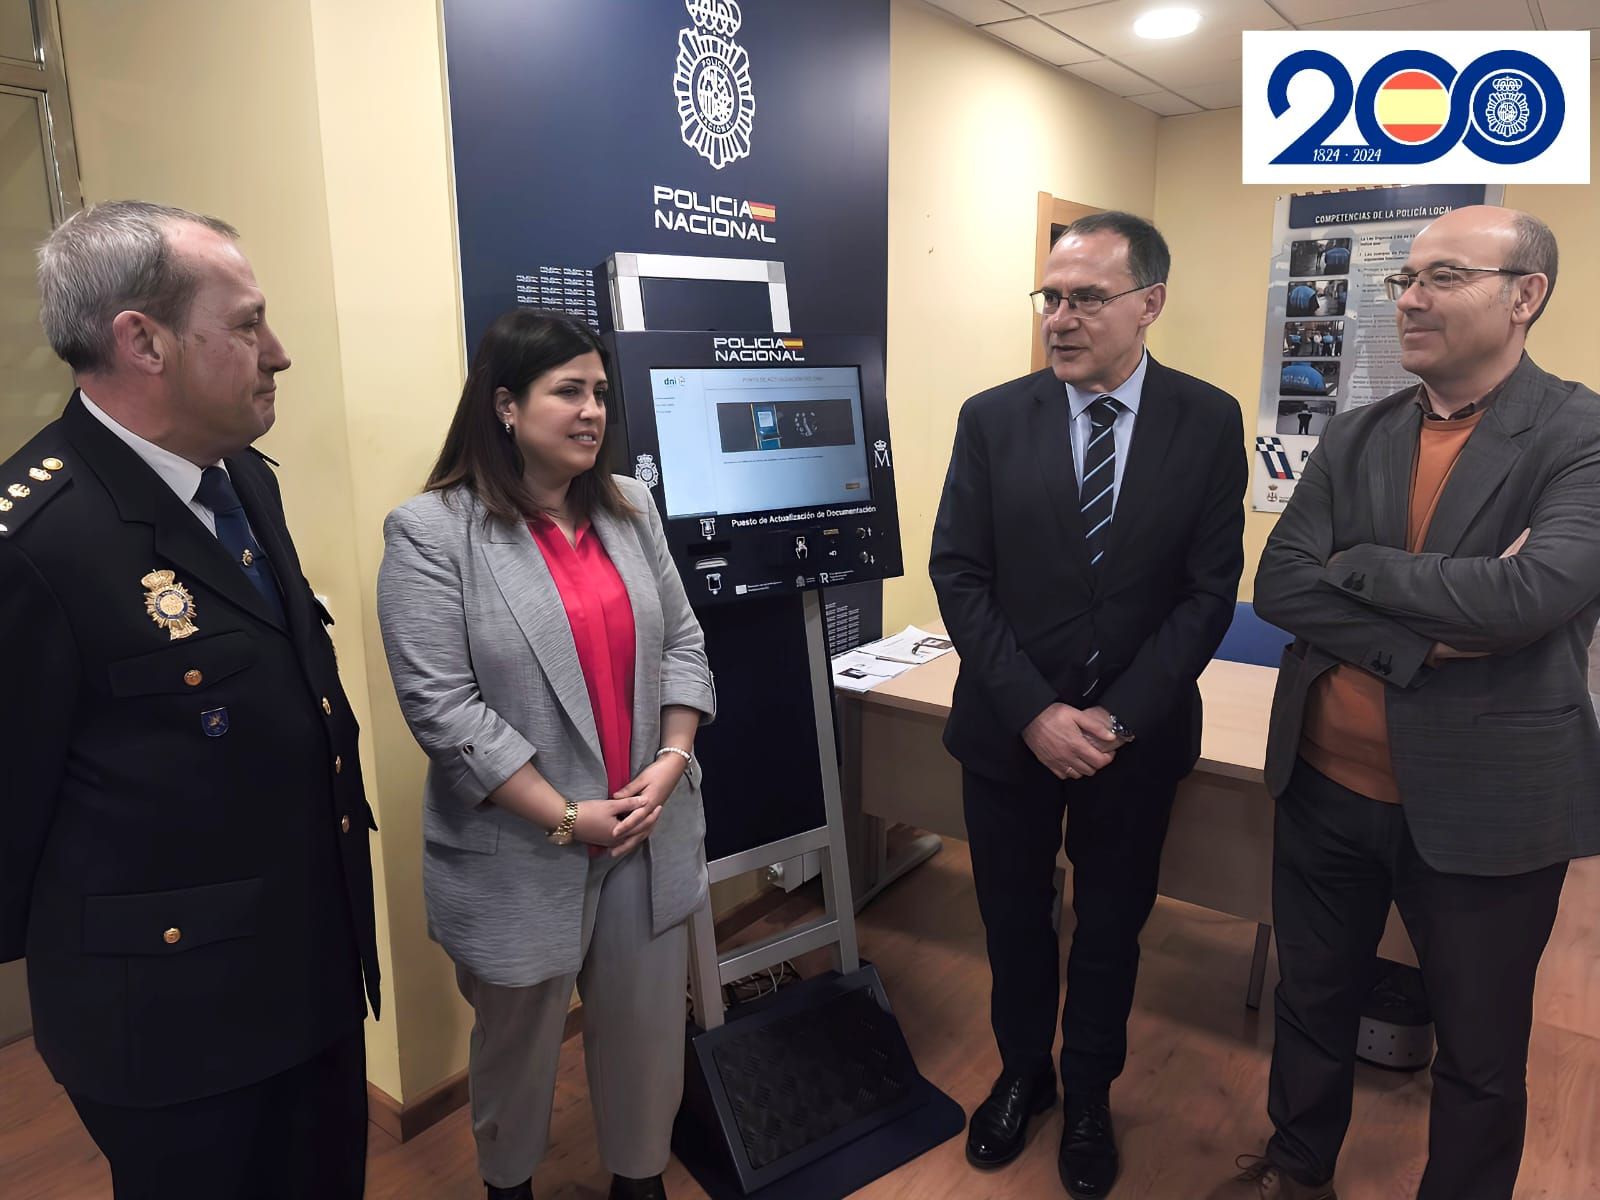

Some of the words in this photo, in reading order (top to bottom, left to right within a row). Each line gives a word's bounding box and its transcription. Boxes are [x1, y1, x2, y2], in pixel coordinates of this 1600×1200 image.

[1315, 210, 1371, 224] COMPETENCIAS
[1373, 210, 1382, 220] DE
[1385, 209, 1394, 219] LA
[1396, 206, 1427, 218] POLICÍA
[654, 209, 776, 243] NACIONAL
[715, 350, 805, 362] NACIONAL
[731, 518, 758, 527] Puesto
[759, 516, 768, 524] de
[769, 511, 815, 523] Actualización
[817, 509, 825, 518] de
